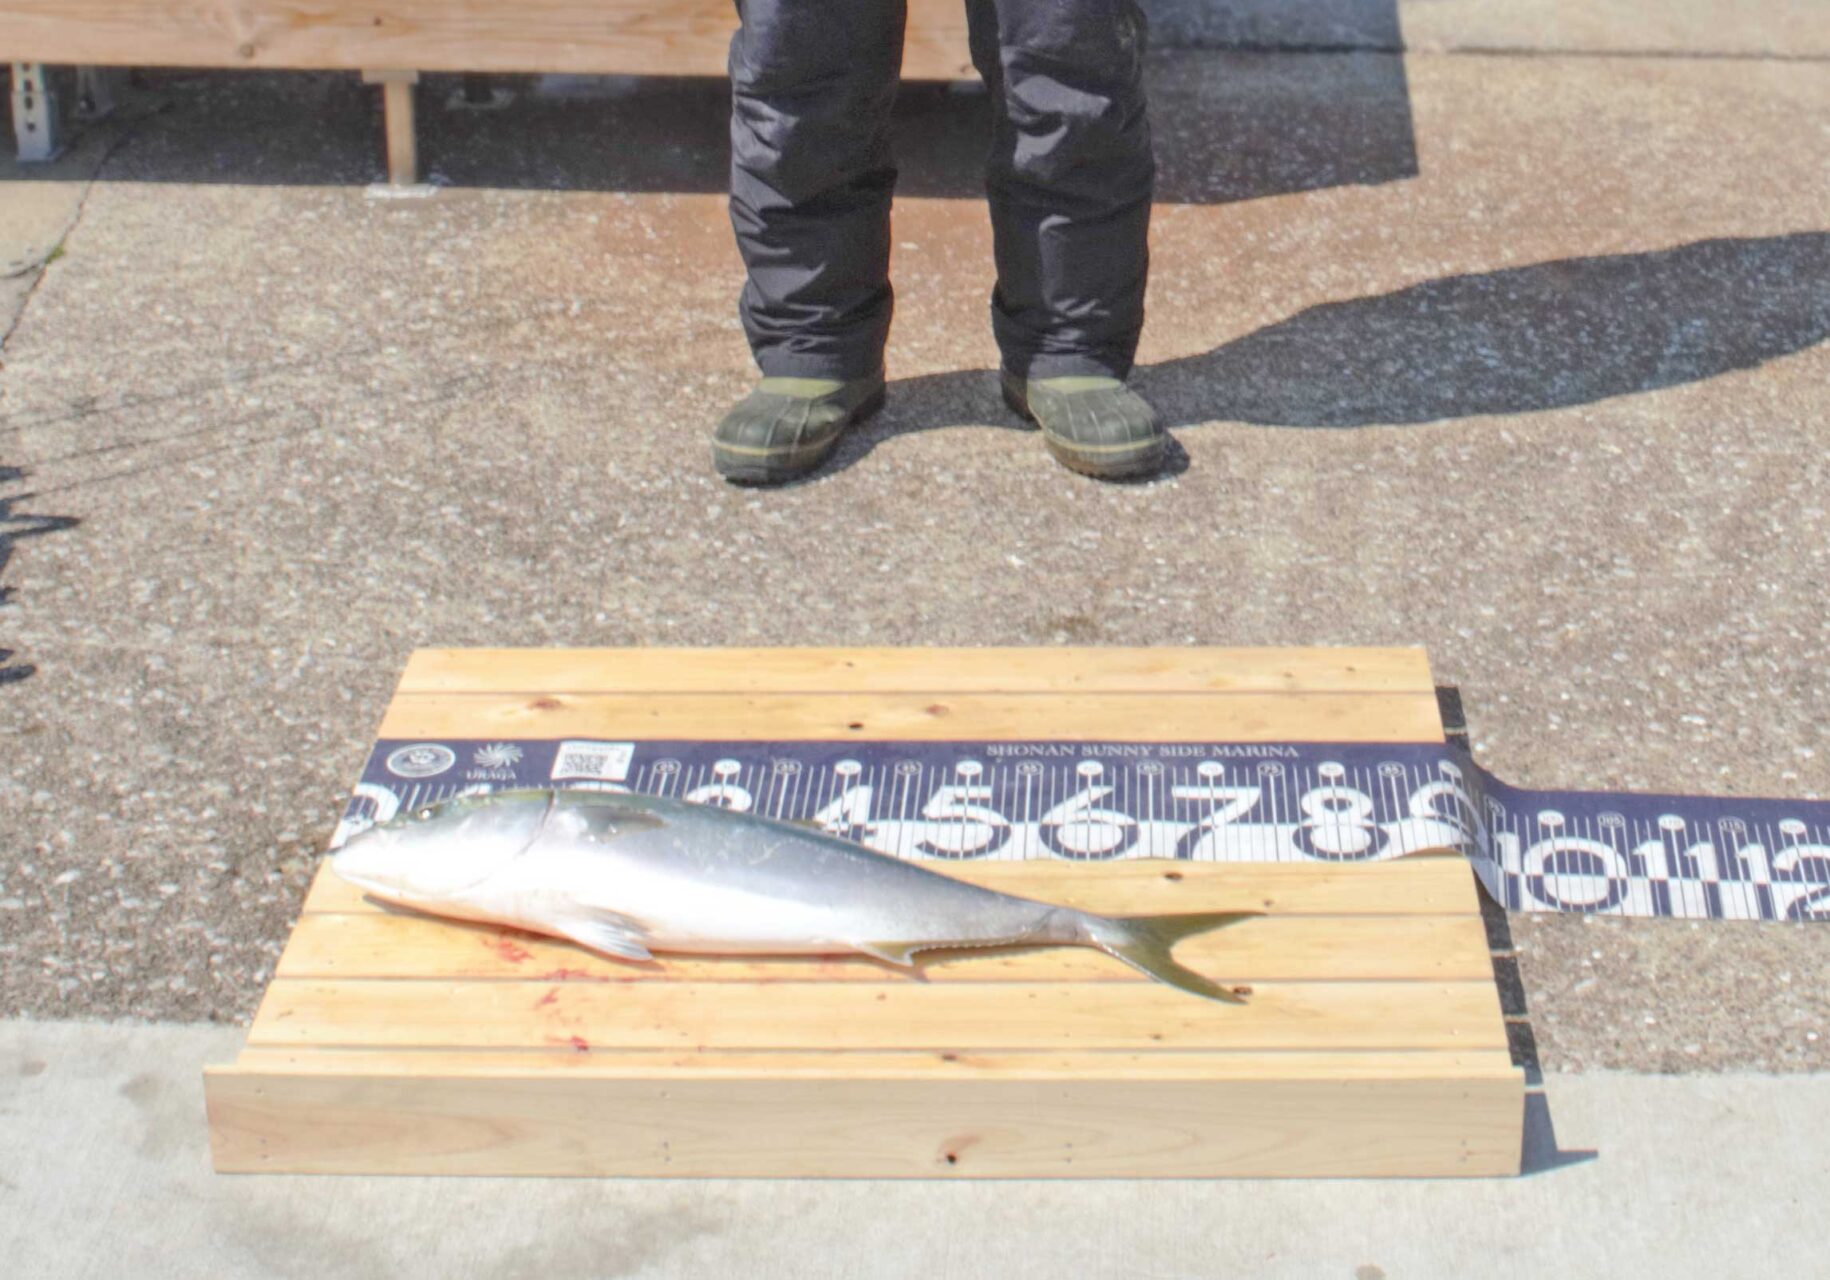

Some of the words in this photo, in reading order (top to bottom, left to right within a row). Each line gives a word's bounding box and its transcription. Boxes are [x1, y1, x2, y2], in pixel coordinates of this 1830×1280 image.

[986, 744, 1076, 757] SHONAN
[1082, 744, 1153, 757] SUNNY
[1159, 745, 1206, 757] SIDE
[1212, 745, 1299, 758] MARINA
[466, 770, 517, 780] URAGA
[813, 785, 878, 846] 4
[915, 786, 1011, 860] 5
[1039, 786, 1141, 860] 6
[1171, 786, 1261, 860] 7
[1292, 786, 1390, 861] 8
[1491, 832, 1629, 912] 10
